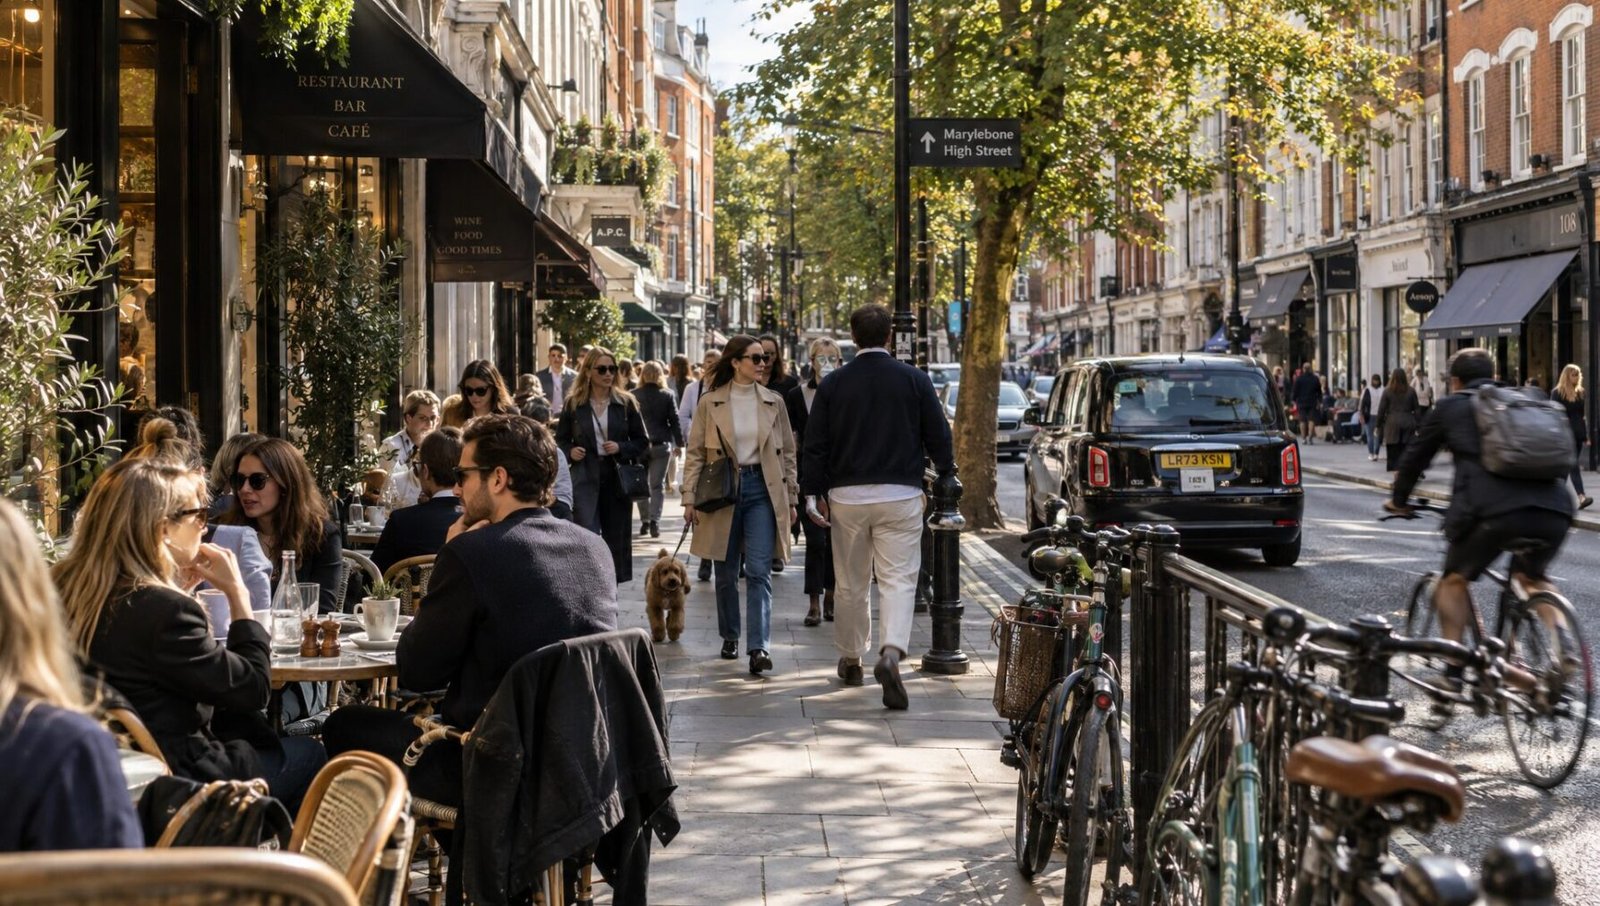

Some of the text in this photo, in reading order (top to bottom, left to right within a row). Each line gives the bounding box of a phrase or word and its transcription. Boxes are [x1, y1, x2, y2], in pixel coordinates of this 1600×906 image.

[298, 75, 404, 89] RESTAURANT
[334, 100, 366, 112] BAR
[328, 123, 370, 137] CAFÉ
[944, 128, 1014, 142] Marylebone
[944, 145, 1012, 158] High Street
[454, 217, 482, 225] WINE
[1560, 212, 1577, 234] 108
[454, 231, 483, 240] FOOD
[596, 228, 626, 237] A.P.C.
[436, 245, 502, 255] GOOD TIMES
[1168, 455, 1224, 465] LR73 KSN
